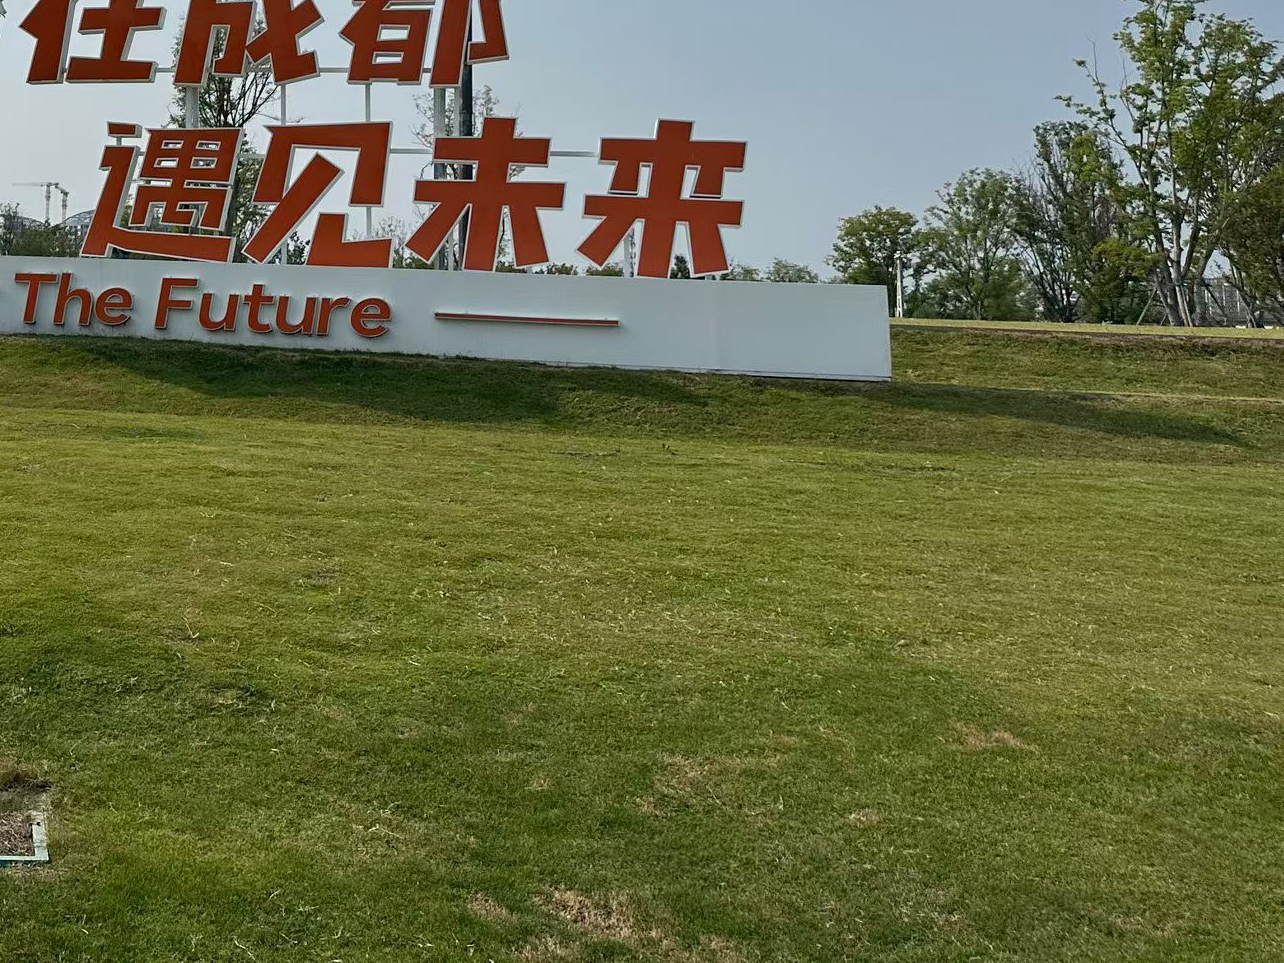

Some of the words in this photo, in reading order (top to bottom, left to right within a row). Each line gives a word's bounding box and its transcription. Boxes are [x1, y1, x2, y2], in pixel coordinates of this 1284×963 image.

[80, 116, 748, 279] 遇见未来
[14, 271, 135, 327] The
[154, 276, 393, 339] Future
